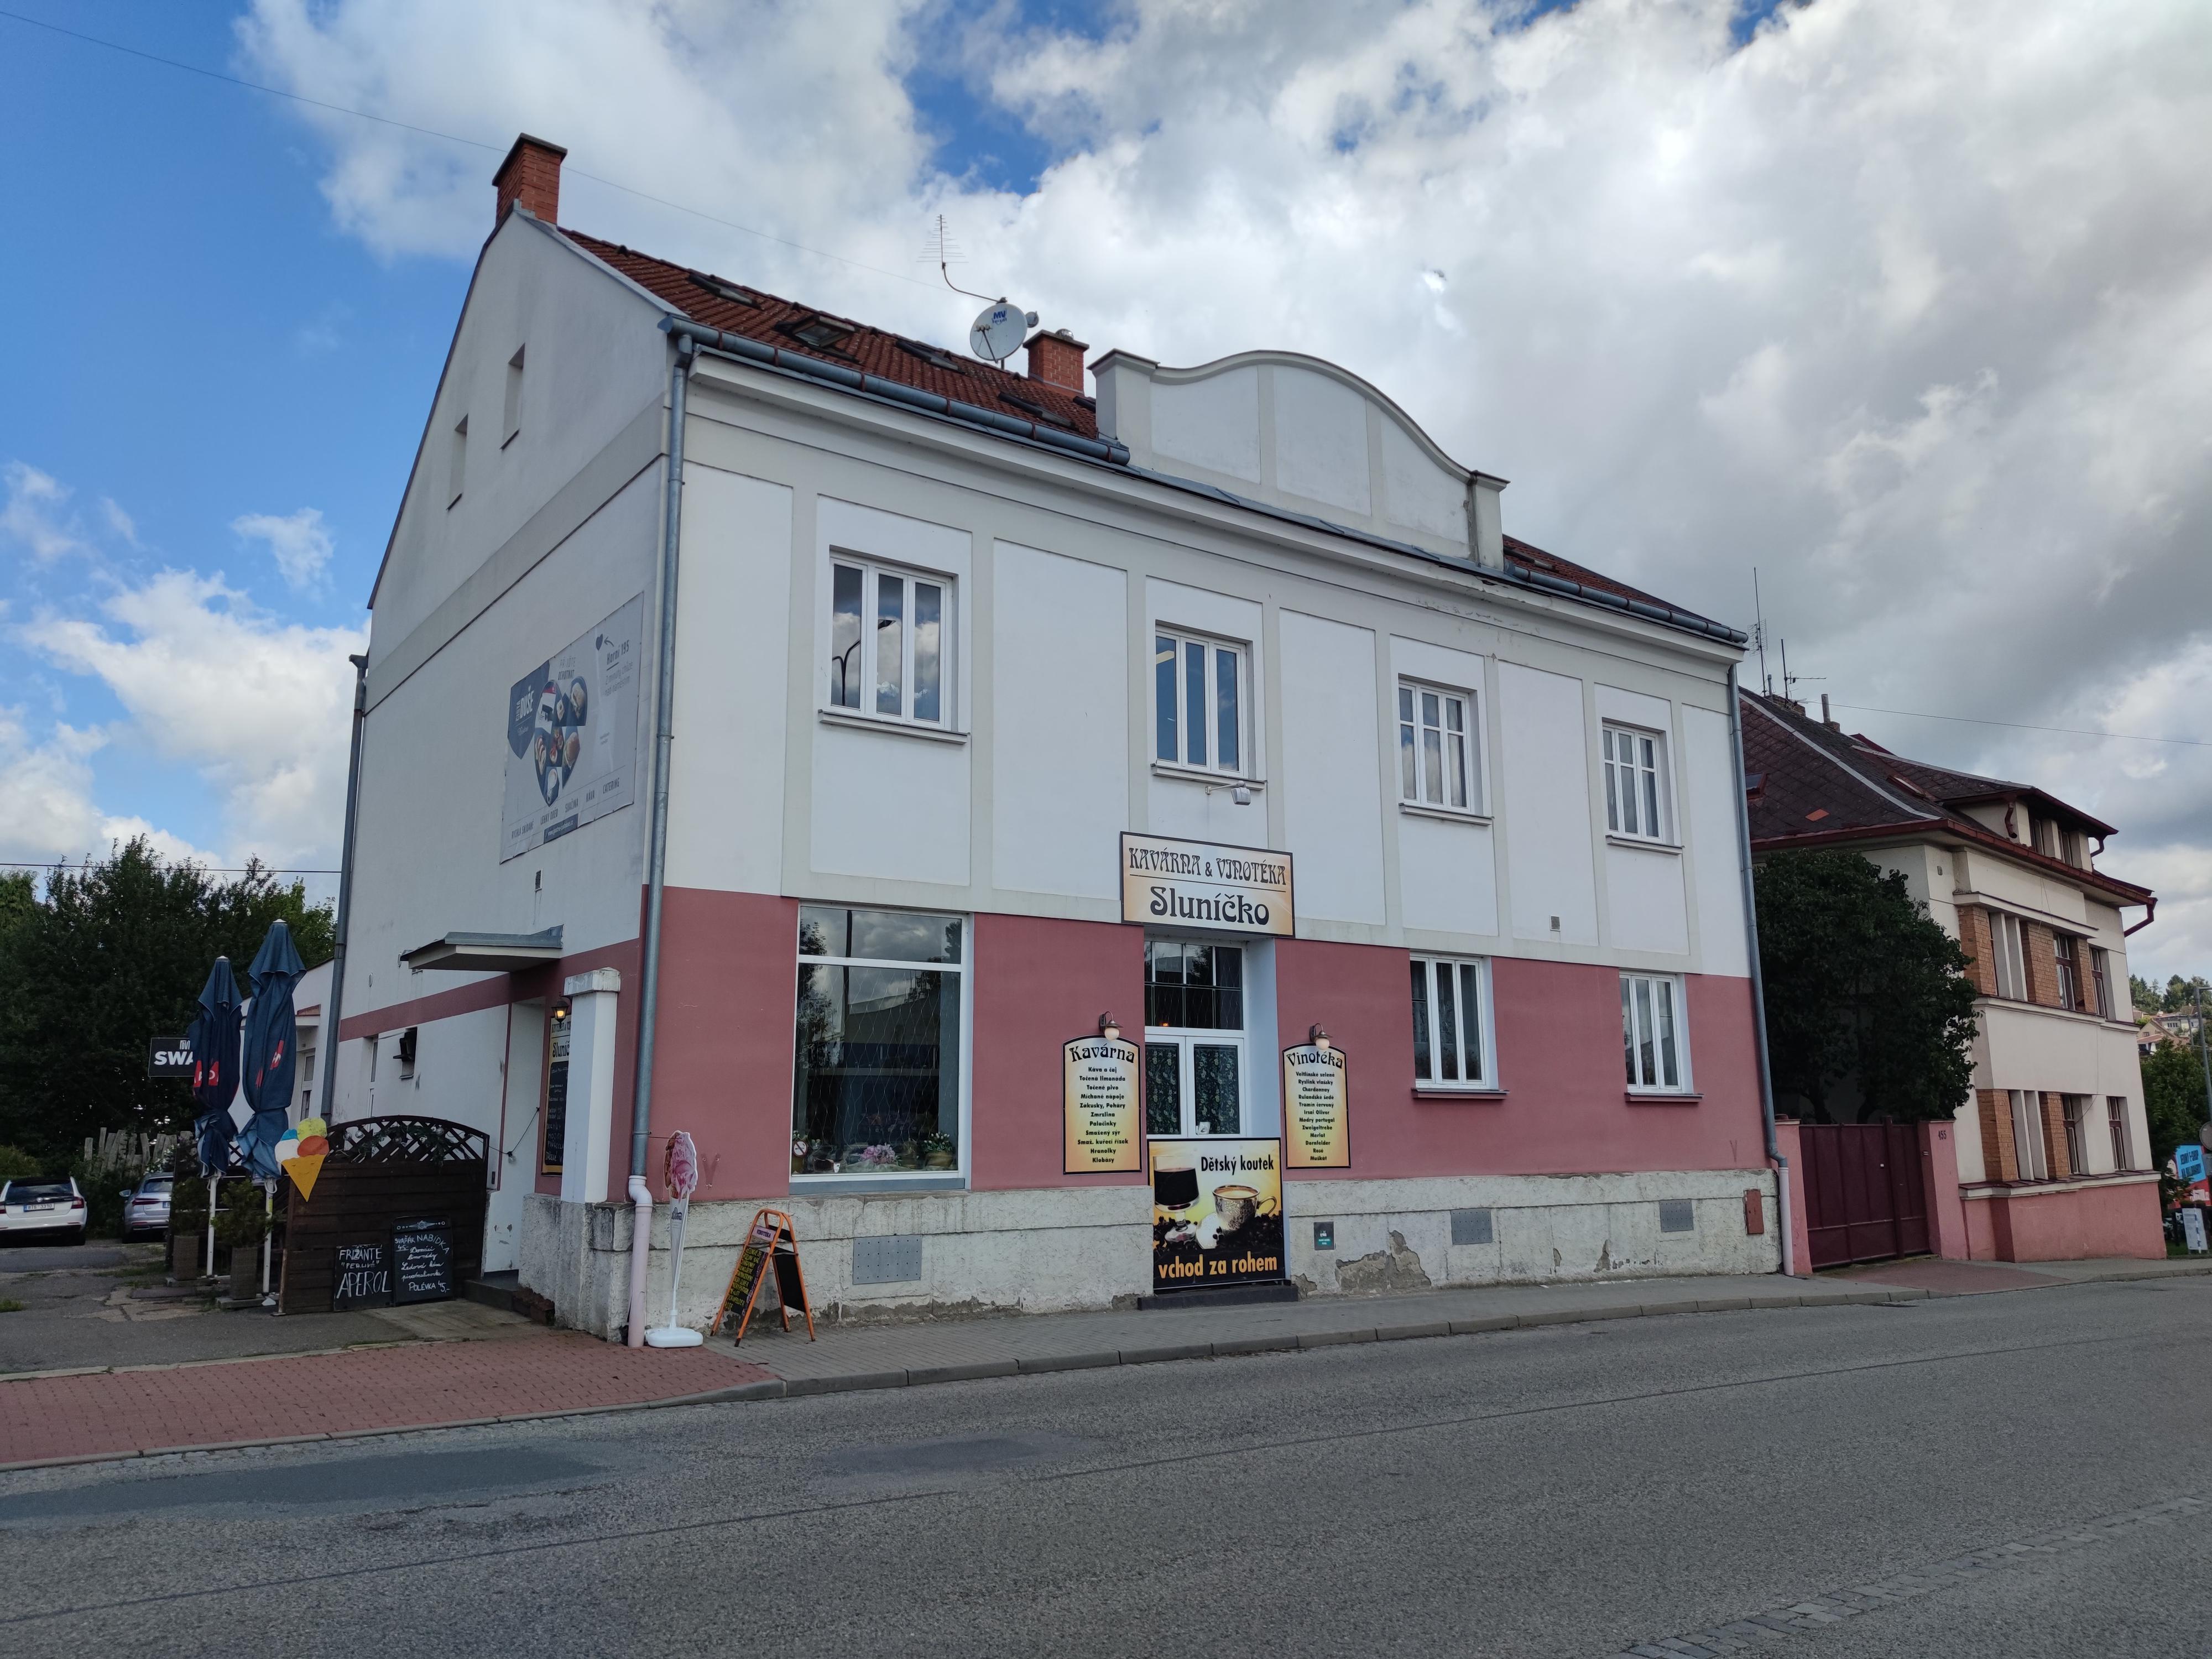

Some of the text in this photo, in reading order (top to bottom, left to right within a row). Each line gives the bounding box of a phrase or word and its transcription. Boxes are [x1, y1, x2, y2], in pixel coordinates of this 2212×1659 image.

[621, 639, 629, 655] 195
[586, 790, 595, 802] KÁVA
[603, 778, 620, 794] CATERING
[1129, 847, 1201, 875] KAVÁRNA
[1205, 862, 1213, 877] &
[1150, 886, 1269, 925] Sluníčko
[1069, 1044, 1135, 1063] Kavárna
[1286, 1051, 1343, 1069] Vinotéka
[1201, 1154, 1274, 1175] Dětský koutek
[401, 1261, 426, 1270] Ledová
[1158, 1251, 1277, 1279] vchod za rohem
[336, 1271, 392, 1298] APEROL
